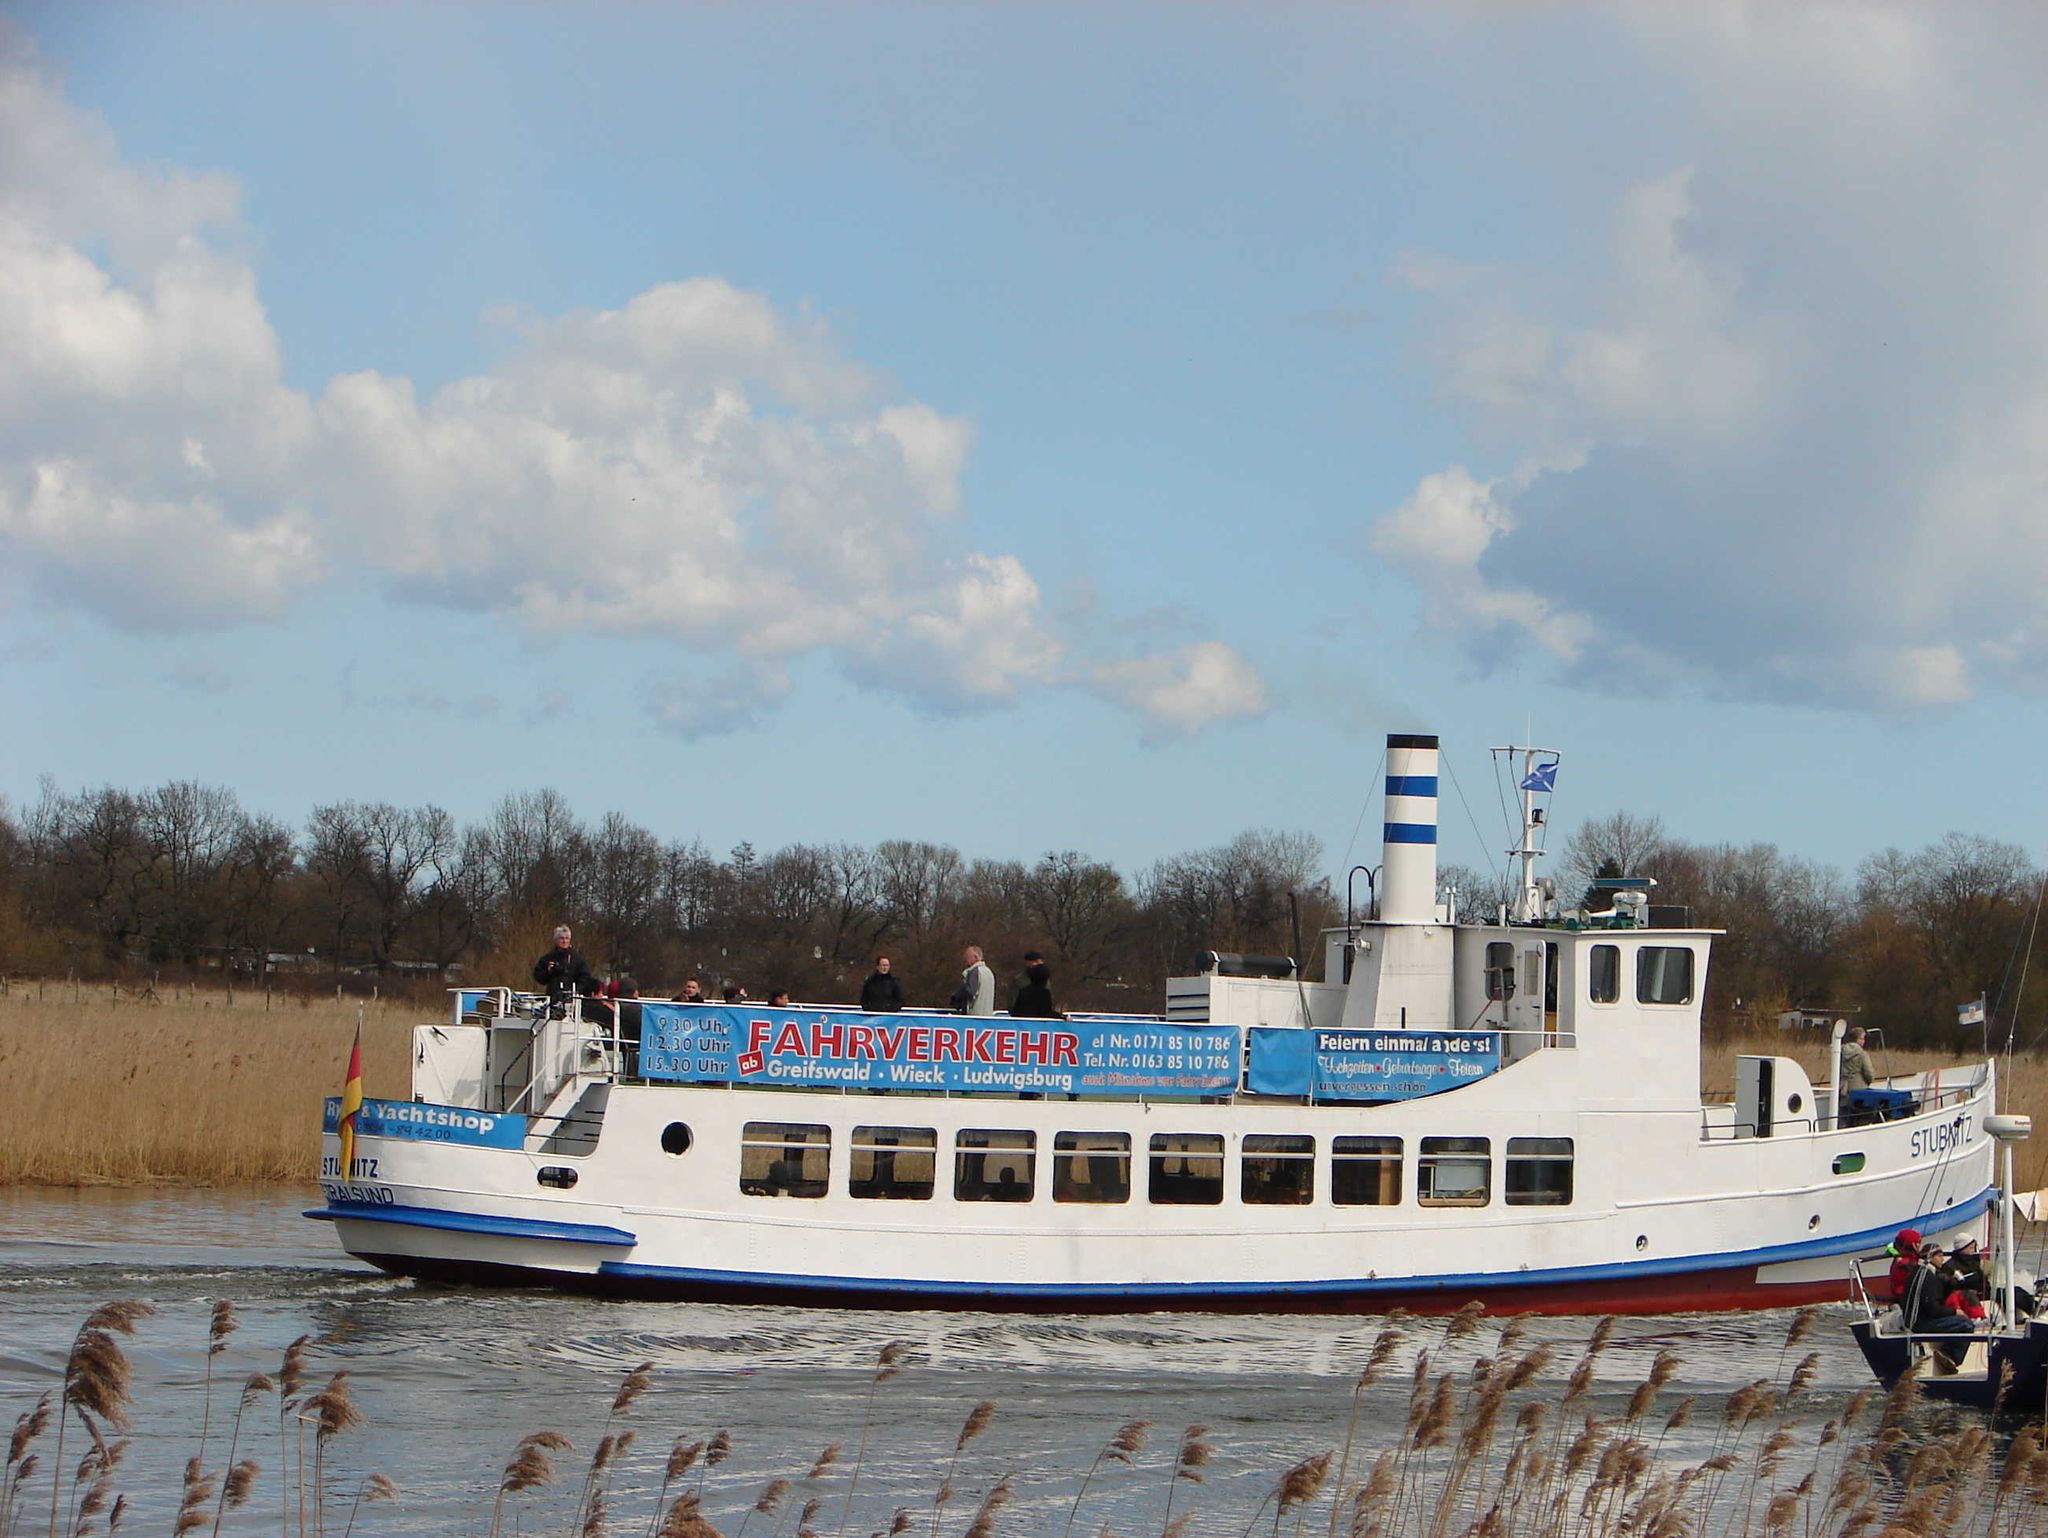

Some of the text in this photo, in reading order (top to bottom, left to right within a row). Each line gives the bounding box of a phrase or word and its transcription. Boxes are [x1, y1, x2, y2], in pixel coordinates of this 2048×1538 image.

[658, 1016, 692, 1035] 9.30
[648, 1034, 731, 1053] 12.30 Uhr
[746, 1019, 1080, 1067] FAHRVERKEHR
[1110, 1034, 1131, 1048] Nr.
[1134, 1034, 1163, 1050] 0171
[1168, 1036, 1183, 1050] 85
[1188, 1036, 1202, 1050] 10
[1206, 1036, 1231, 1051] 786
[1319, 1034, 1370, 1051] Feiern
[1374, 1035, 1428, 1052] einmal
[646, 1055, 730, 1074] 15.30 Uhr
[1083, 1053, 1230, 1070] Tel. Nr. 0163 85 10 786
[741, 1057, 1073, 1090] ab Greifswald Wieck Ludwigsburg
[361, 1104, 370, 1118] &
[376, 1103, 495, 1135] Yachtshop
[322, 1157, 379, 1178] STUNITZ
